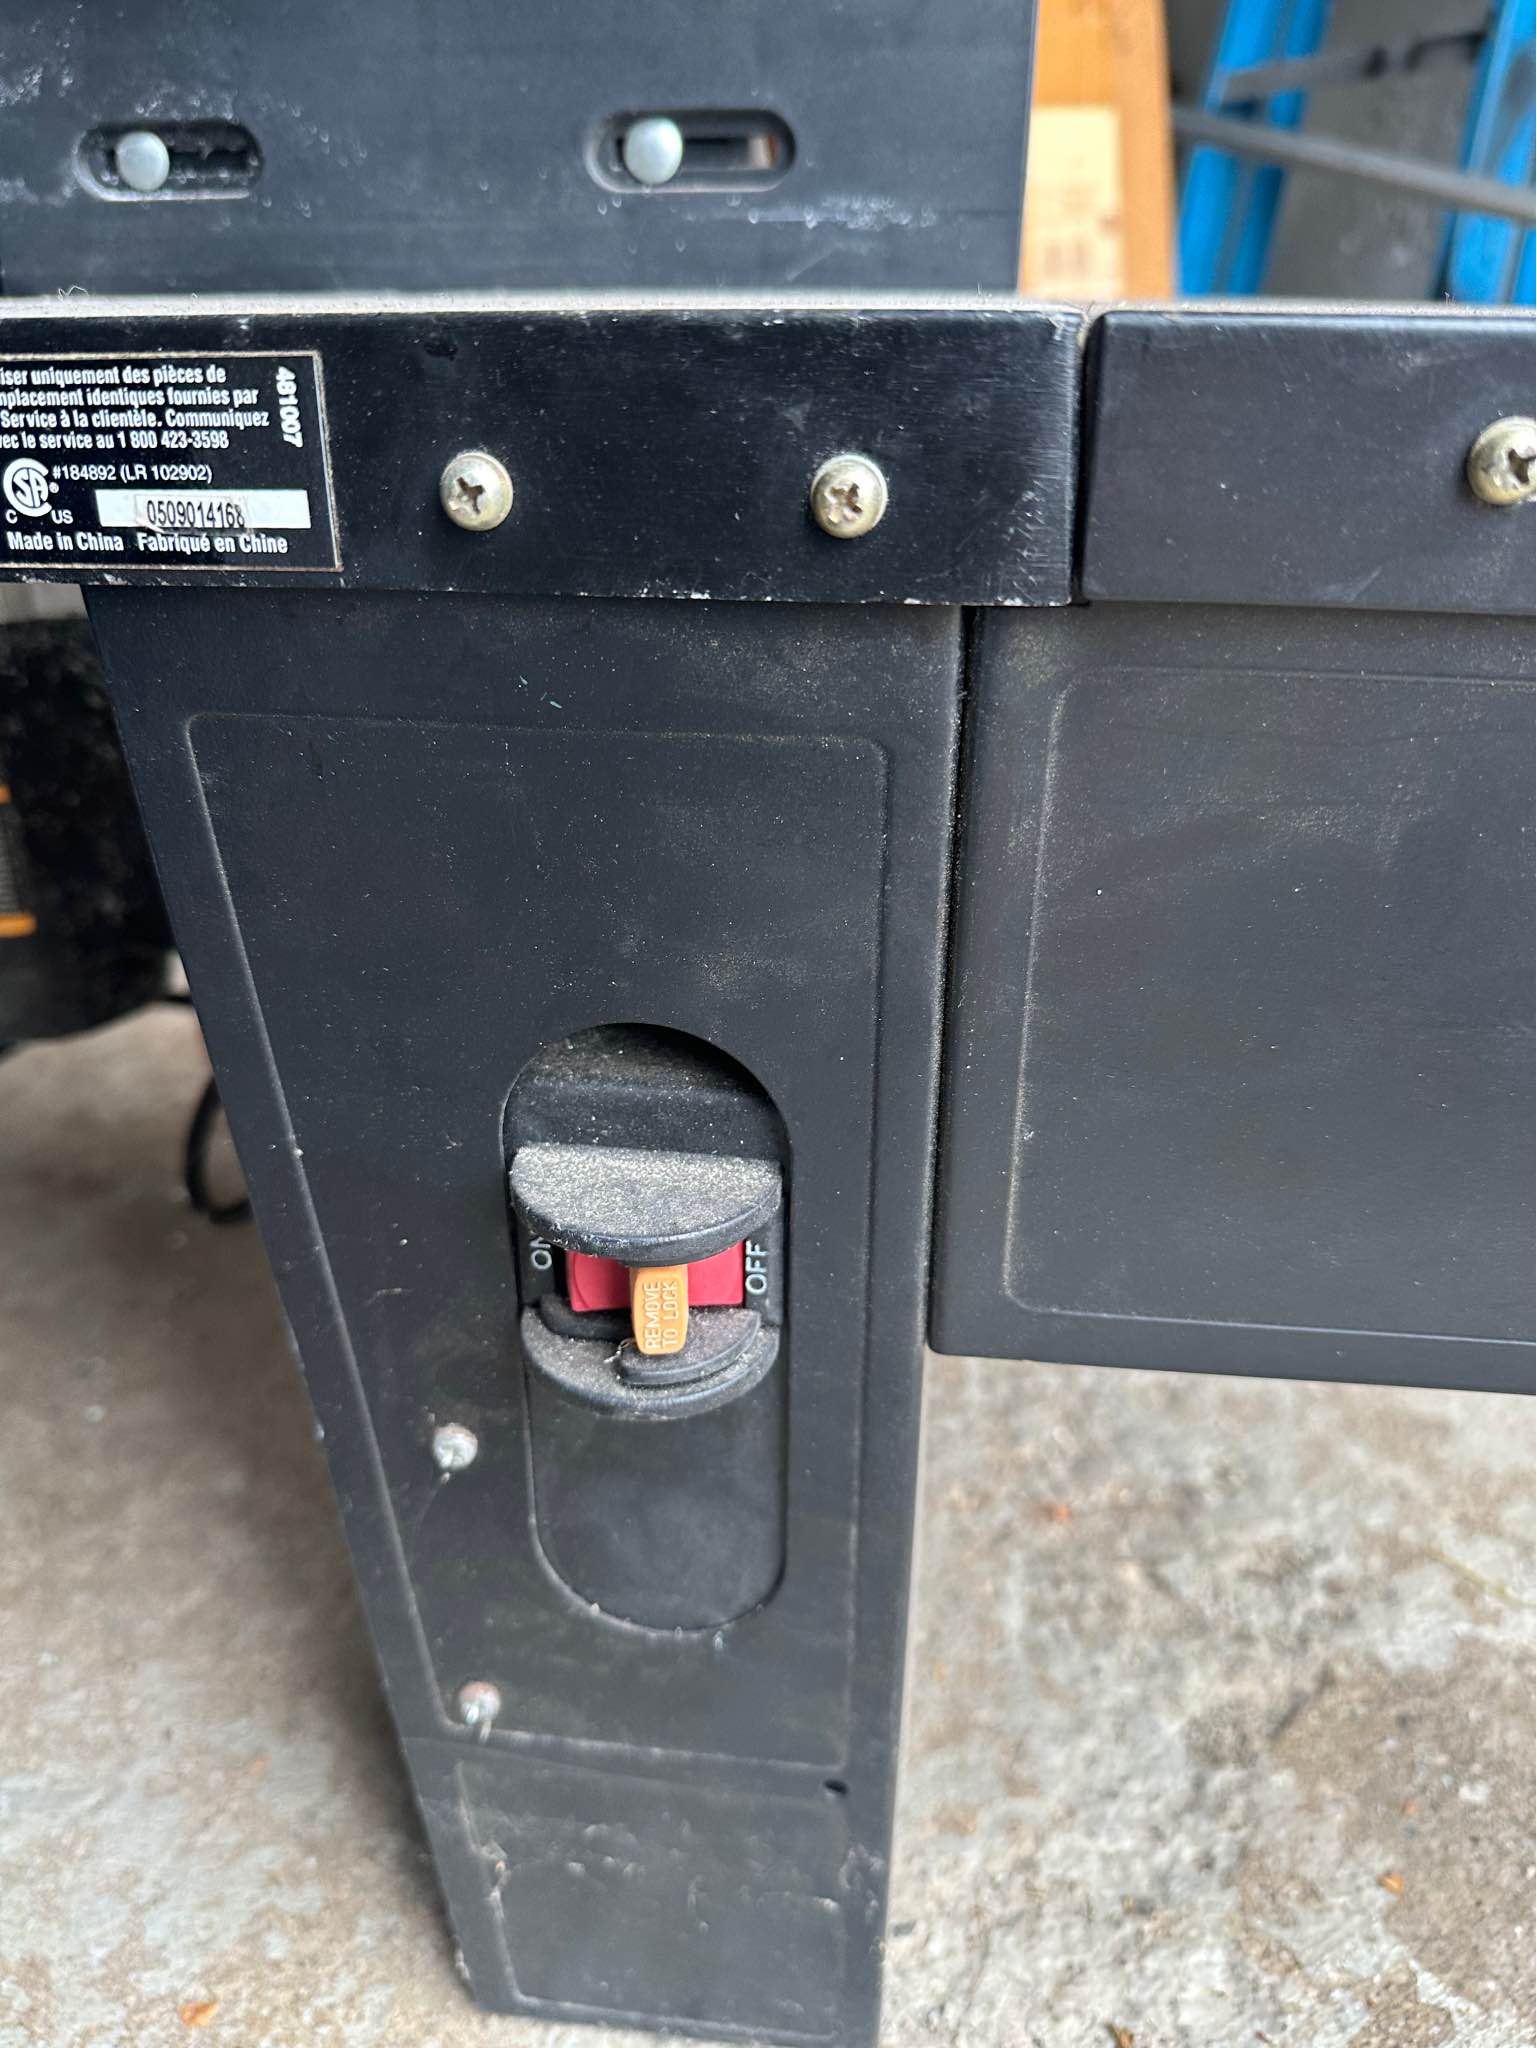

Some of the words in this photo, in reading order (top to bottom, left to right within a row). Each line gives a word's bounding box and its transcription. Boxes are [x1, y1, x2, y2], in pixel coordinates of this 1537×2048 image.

[30, 366, 120, 388] uniquement
[122, 365, 150, 384] des
[152, 364, 204, 387] pièces
[206, 364, 227, 383] de
[86, 387, 165, 409] identiques
[167, 386, 230, 406] fournies
[232, 388, 259, 408] par
[275, 366, 303, 448] 481007
[1, 409, 57, 428] Service
[60, 409, 71, 428] à
[73, 409, 89, 428] la
[91, 408, 162, 428] clientèle.
[165, 408, 270, 430] Communiquez
[0, 433, 20, 449] ec
[21, 430, 37, 449] le
[39, 431, 93, 449] service
[96, 433, 115, 449] au
[117, 431, 126, 448] 1
[130, 430, 158, 449] 800
[161, 430, 229, 449] 423-3598
[52, 464, 117, 481] #184892
[120, 464, 148, 484] (LR
[151, 464, 212, 484] 102902)
[6, 531, 54, 550] Made
[56, 531, 74, 551] in
[75, 531, 125, 551] China
[136, 531, 211, 555] Fabriqué
[214, 536, 236, 553] en
[239, 534, 288, 554] Chine
[745, 1239, 768, 1295] OFF
[662, 1280, 680, 1322] LOCK
[643, 1281, 662, 1349] REMOVE
[662, 1326, 679, 1349] TO
